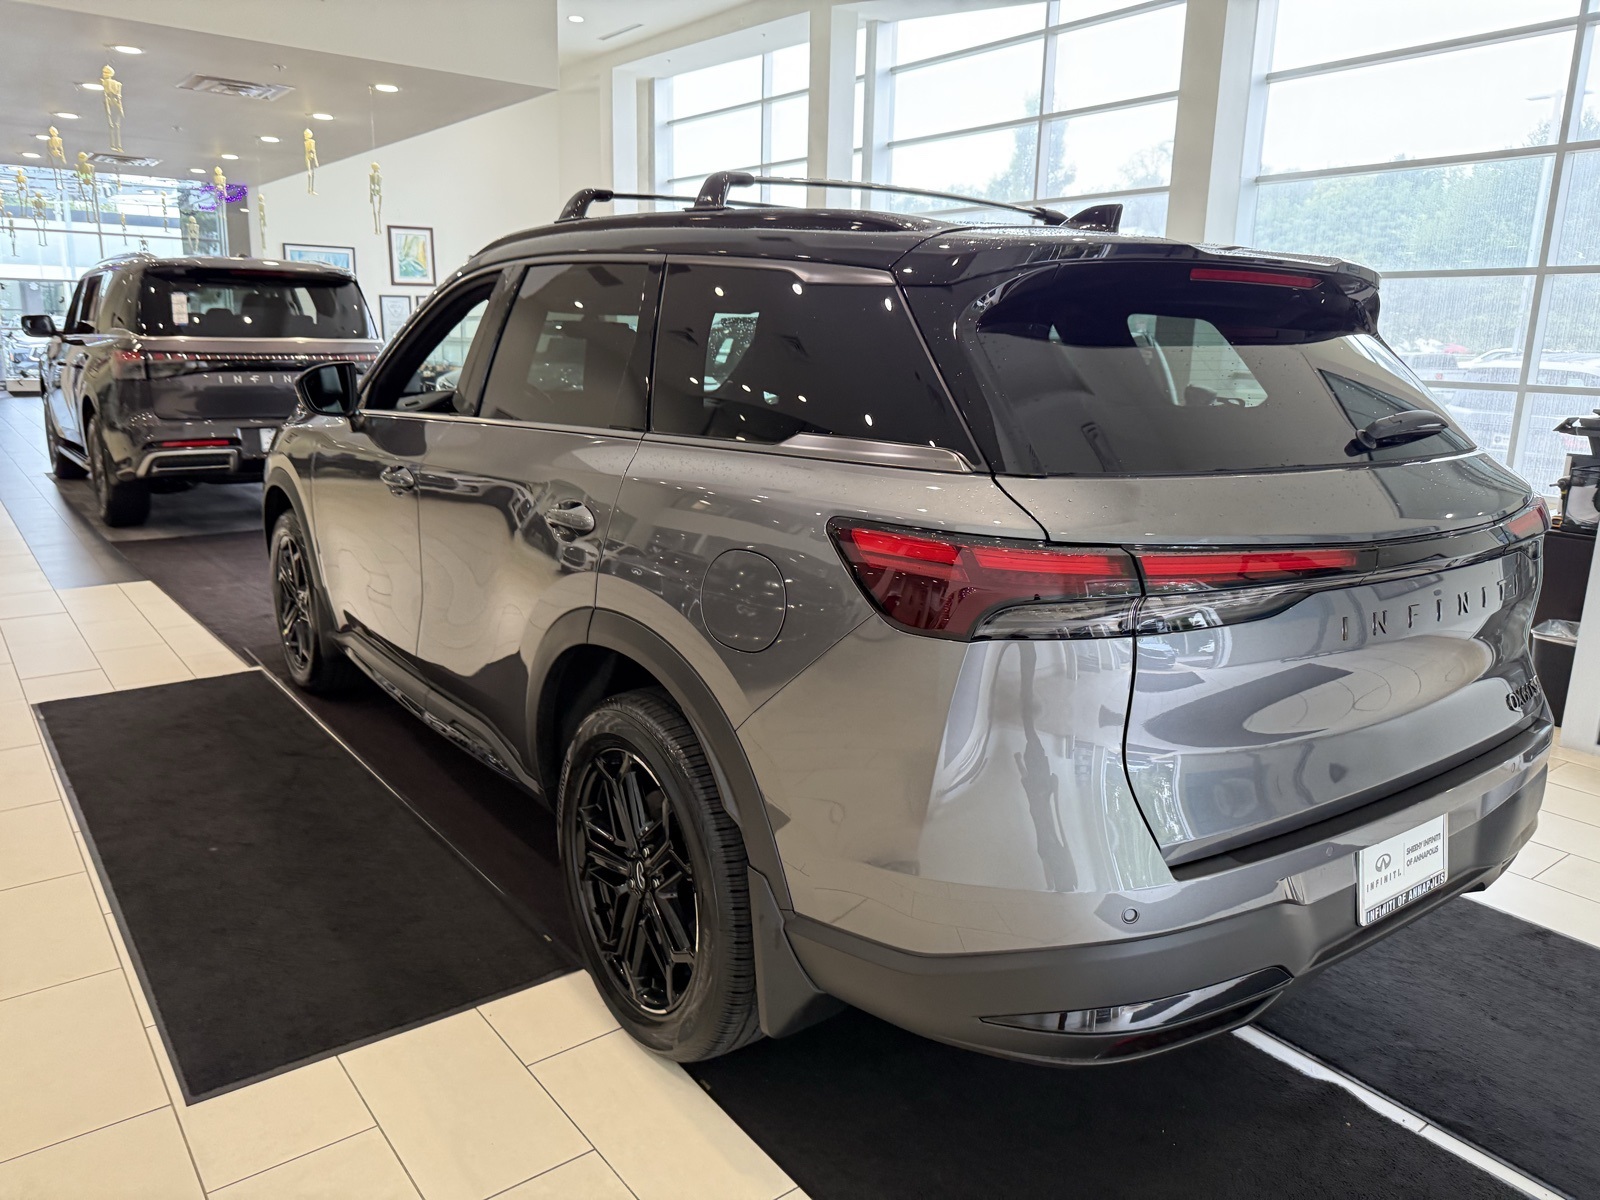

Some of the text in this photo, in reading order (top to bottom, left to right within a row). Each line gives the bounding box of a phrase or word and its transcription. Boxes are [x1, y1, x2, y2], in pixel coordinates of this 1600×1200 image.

[218, 374, 292, 384] INFIN
[1341, 573, 1518, 641] INFINITI
[1413, 845, 1439, 863] ANNAPOLIS
[1366, 869, 1401, 893] INFINITI
[1366, 899, 1396, 923] INFINITI
[1397, 894, 1407, 908] OF
